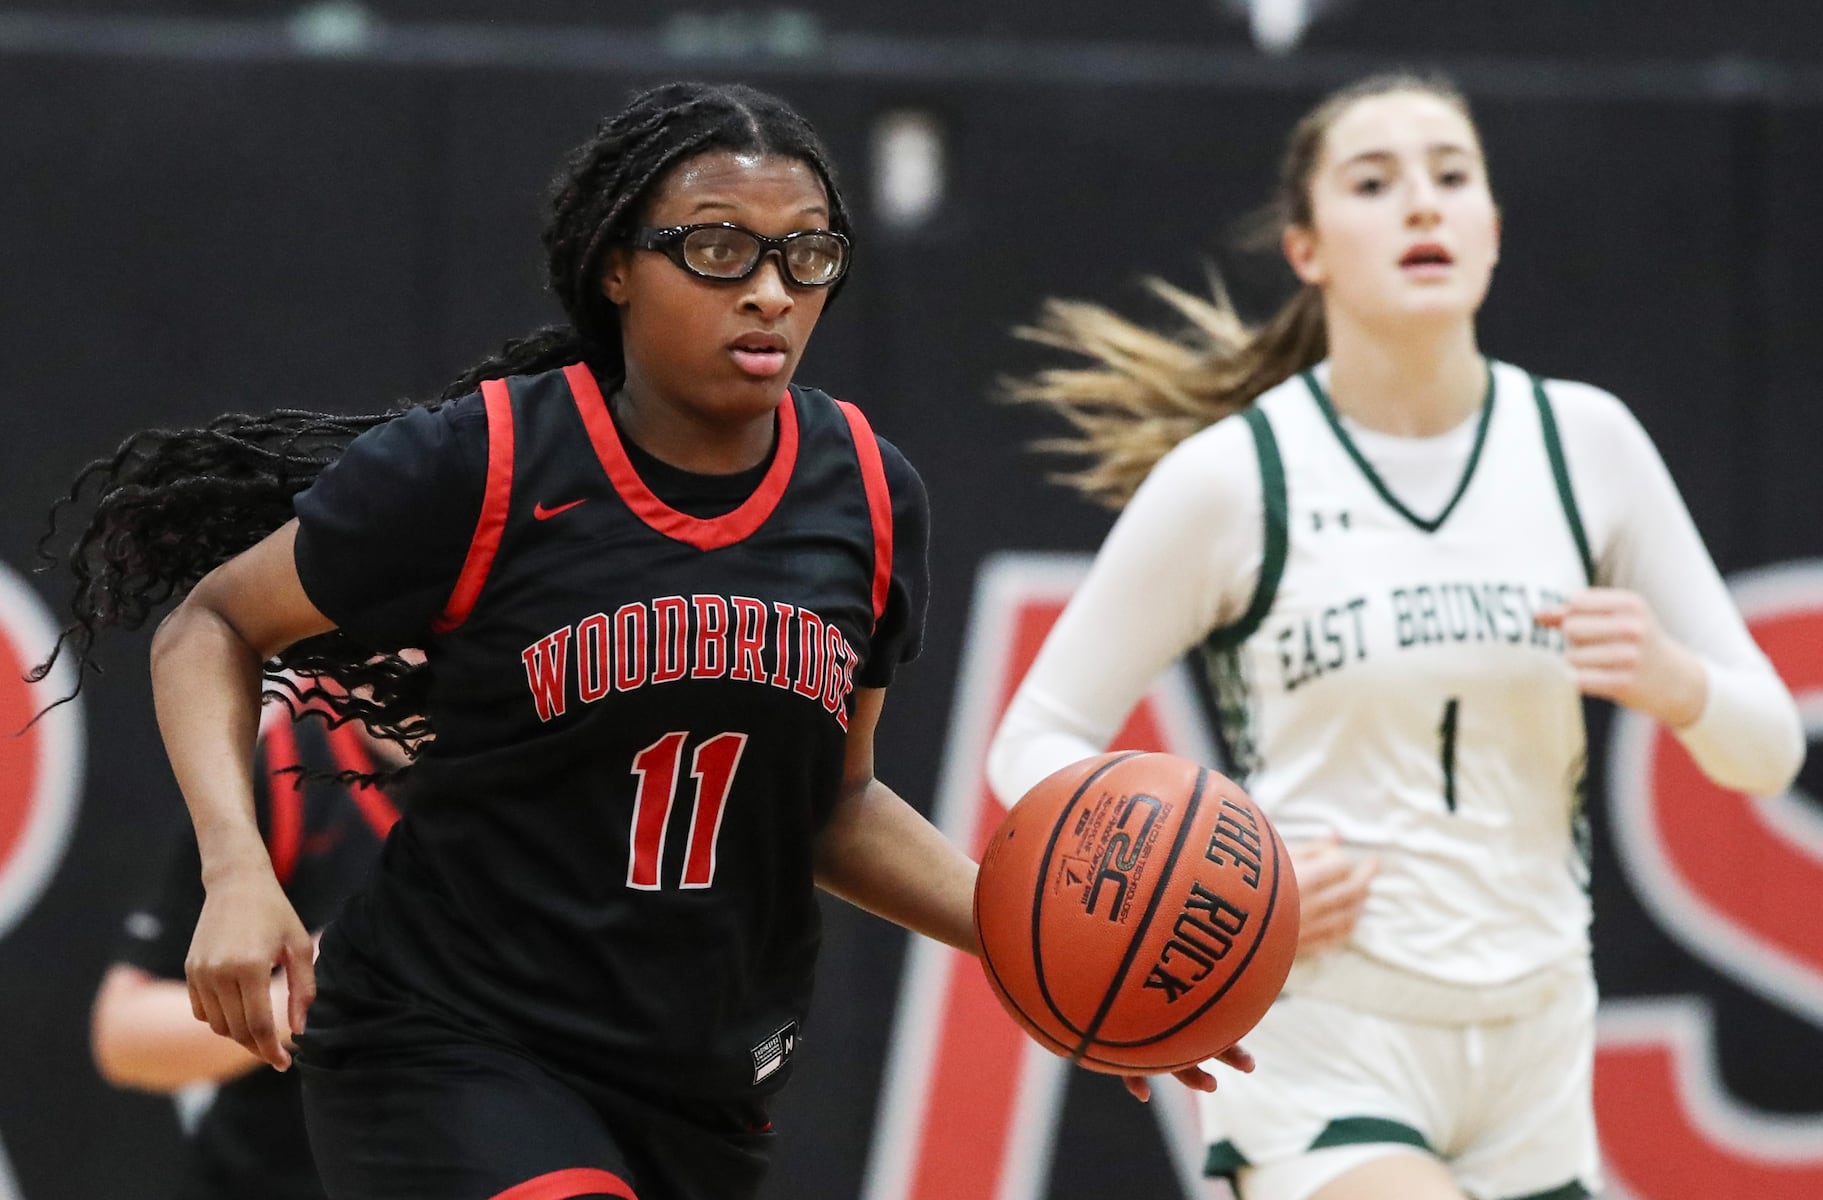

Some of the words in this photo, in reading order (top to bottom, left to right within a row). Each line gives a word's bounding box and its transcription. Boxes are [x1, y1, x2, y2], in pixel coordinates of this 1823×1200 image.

[522, 594, 859, 734] WOODBRIDGE
[1277, 596, 1367, 691] EAST
[626, 731, 749, 891] 11
[1439, 696, 1460, 814] 1
[1119, 860, 1146, 925] TECHNOLOGY
[1204, 797, 1264, 890] THE
[1142, 879, 1250, 1004] ROCK
